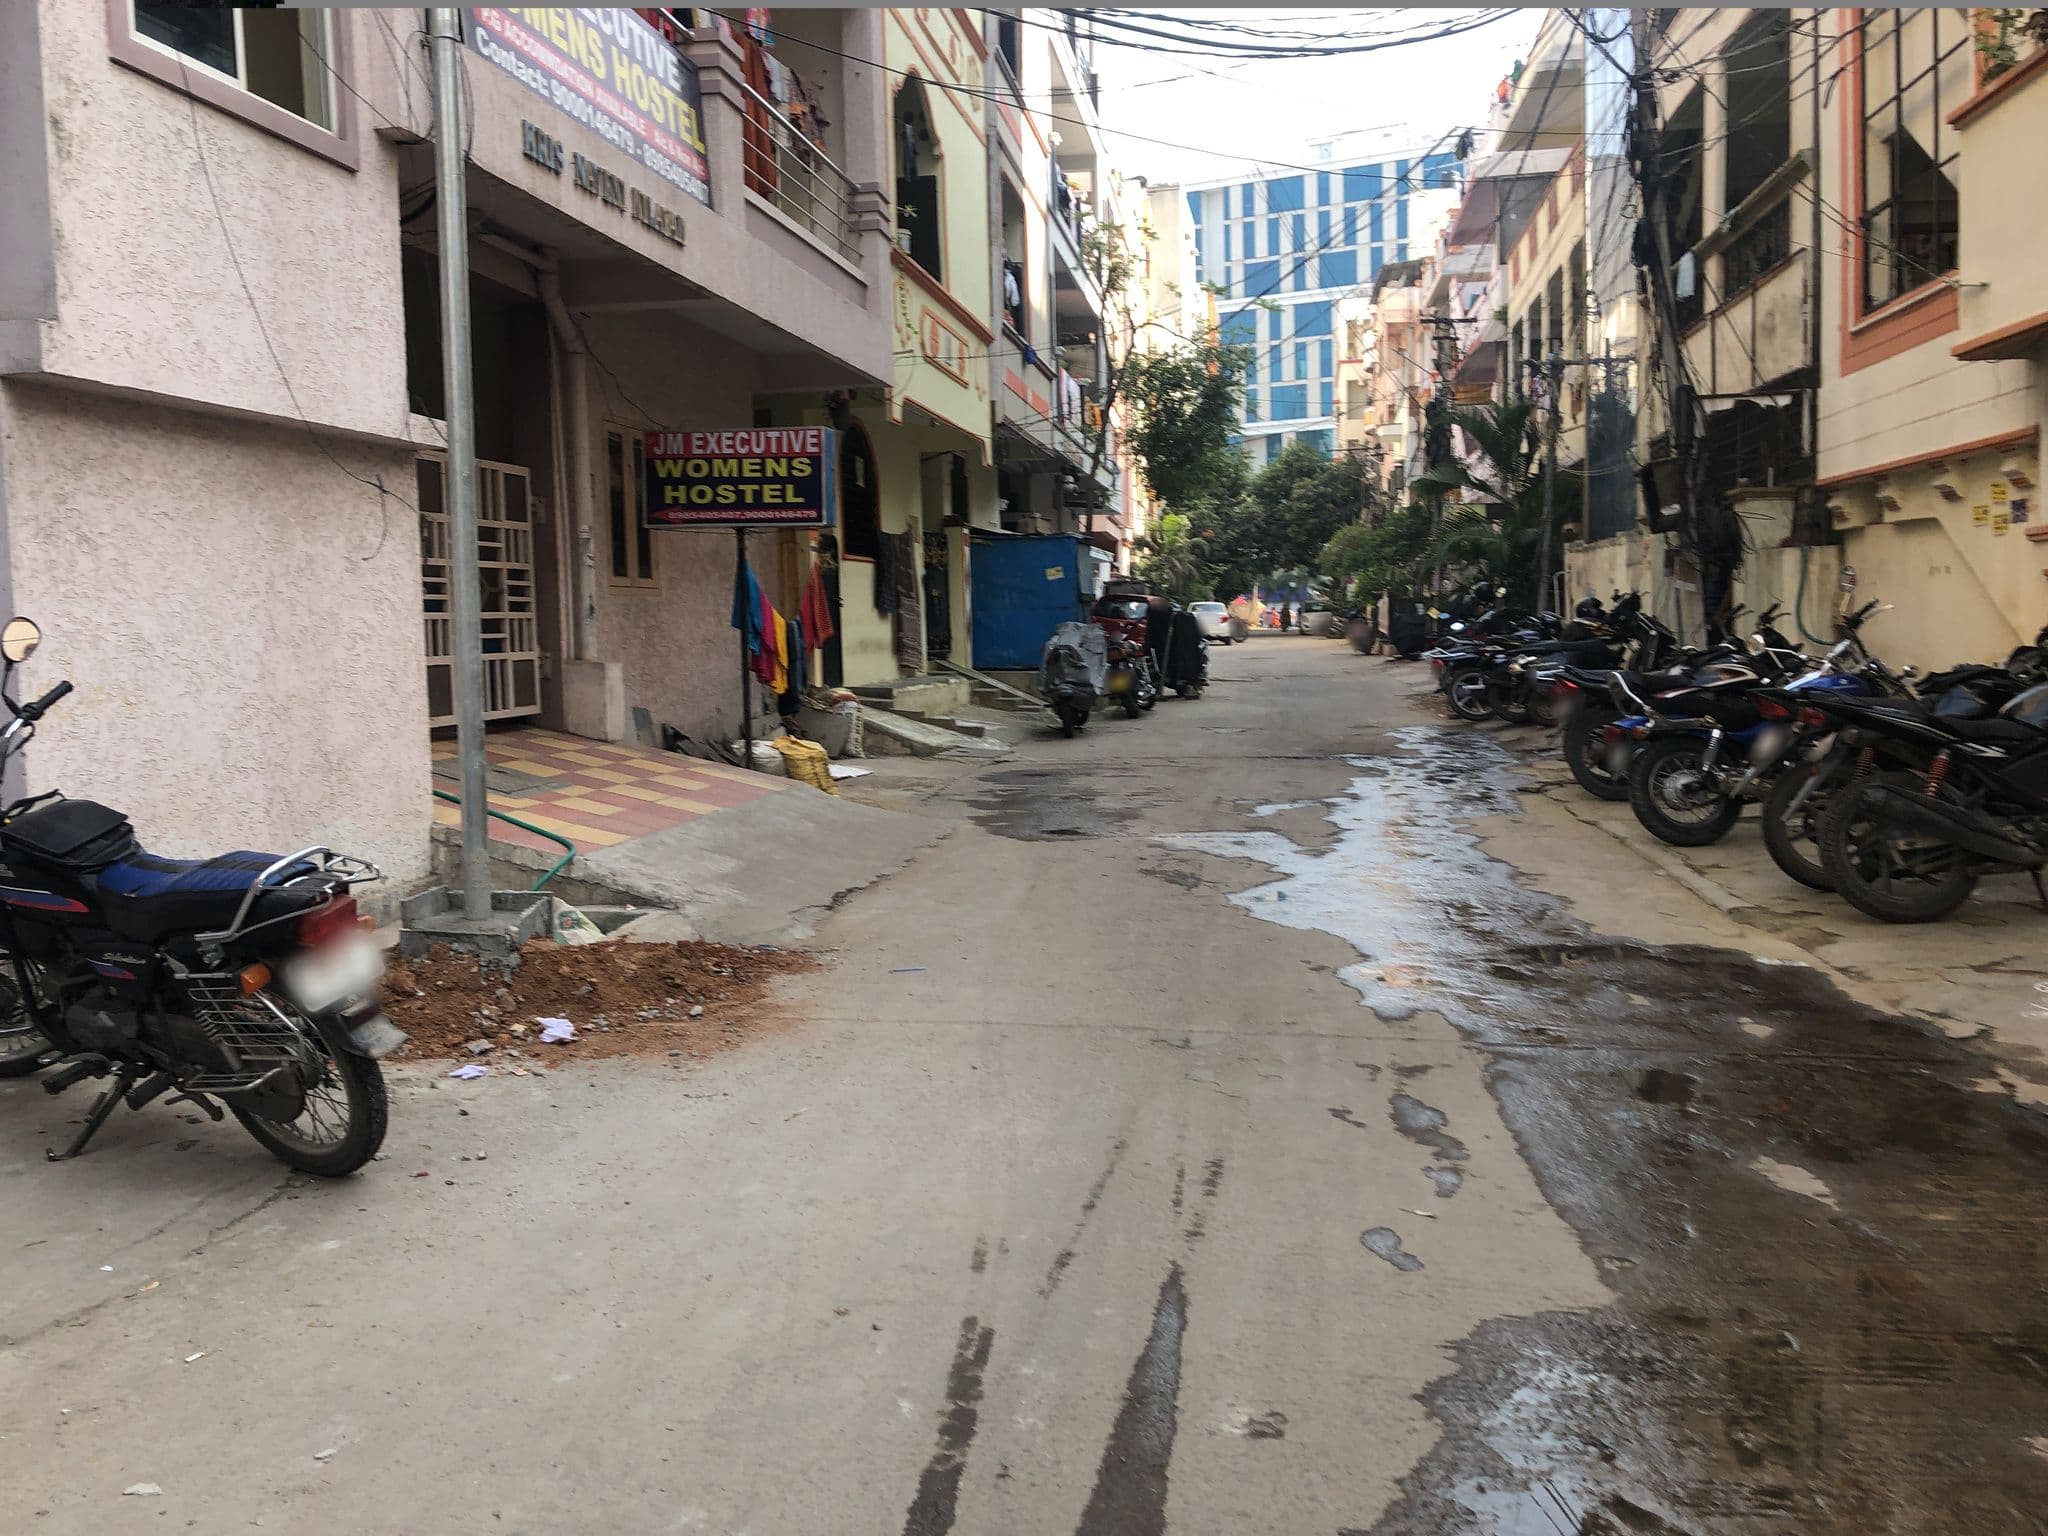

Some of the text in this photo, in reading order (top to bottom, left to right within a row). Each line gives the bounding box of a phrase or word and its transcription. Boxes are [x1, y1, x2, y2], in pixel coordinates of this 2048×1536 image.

[612, 46, 706, 155] HOSTEL
[654, 430, 820, 455] JM EXECUTIVE
[654, 457, 813, 478] WOMENS
[663, 484, 805, 504] HOSTEL
